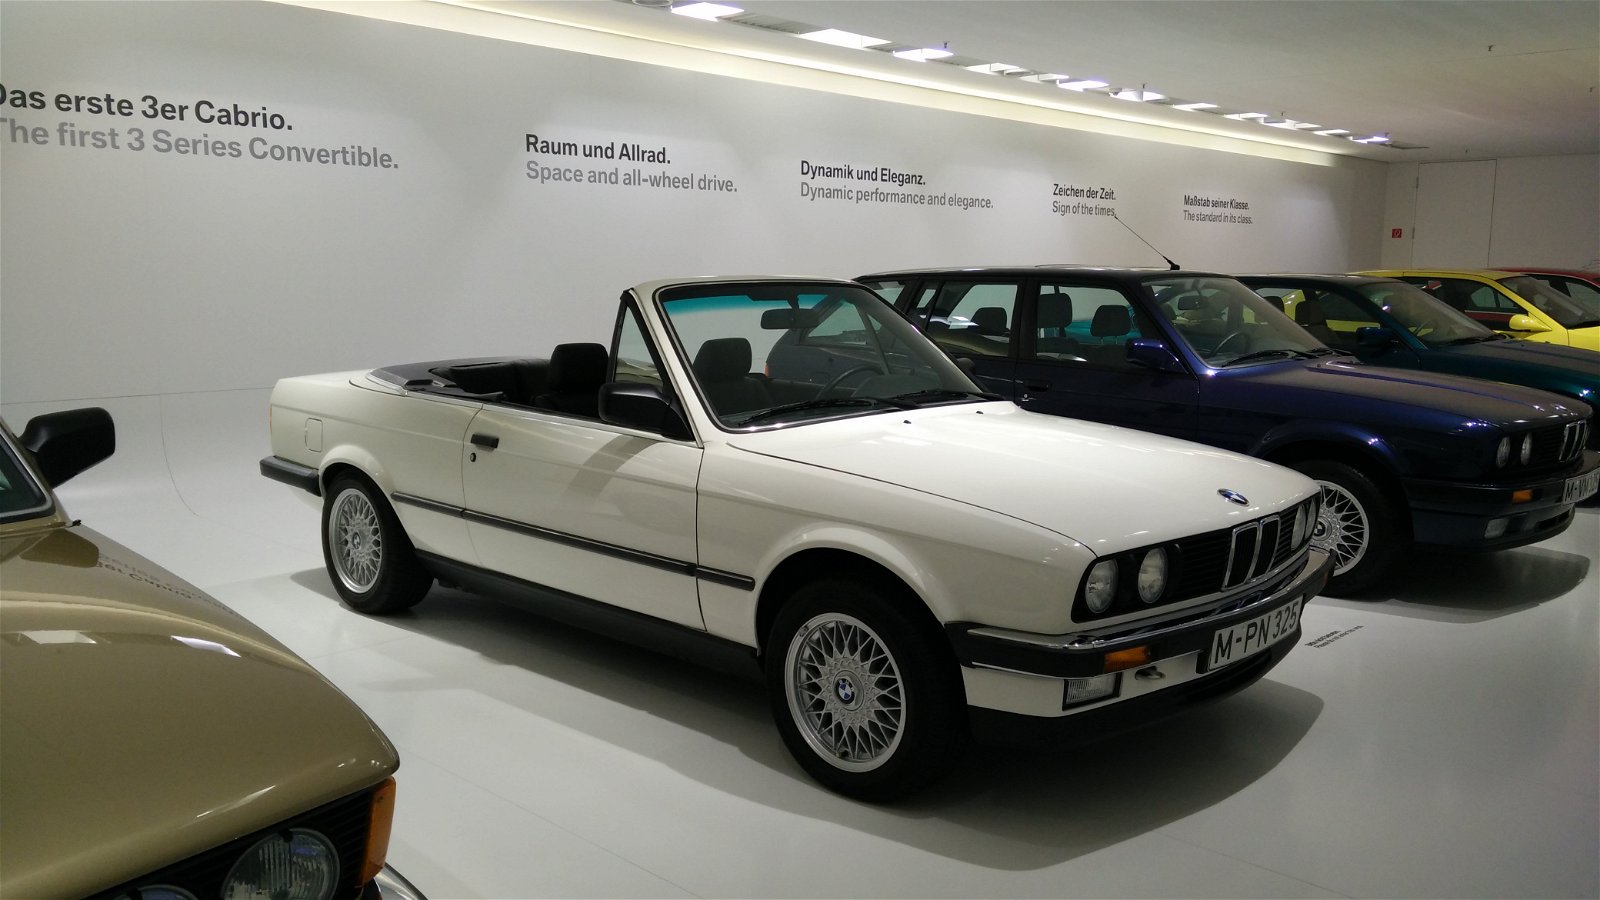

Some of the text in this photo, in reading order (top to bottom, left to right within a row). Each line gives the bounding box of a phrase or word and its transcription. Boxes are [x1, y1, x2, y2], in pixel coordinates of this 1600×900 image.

[54, 93, 134, 117] erste
[141, 94, 189, 122] 3er
[194, 99, 293, 131] Cabrio.
[56, 121, 121, 150] first
[126, 127, 146, 152] 3
[152, 128, 243, 159] Series
[248, 137, 400, 170] Convertible.
[525, 133, 671, 165] Raum und Allrad.
[525, 160, 738, 193] Space and all-wheel drive.
[800, 159, 926, 187] Dynamik und Eleganz.
[800, 181, 994, 211] Dynamic performance and elegance.
[1052, 183, 1116, 201] Zeichen der Zeit.
[1211, 197, 1230, 209] seiner
[1229, 198, 1250, 211] Klasse.
[1052, 200, 1071, 217] Sign
[1071, 202, 1081, 215] of
[1081, 202, 1094, 216] the
[1183, 209, 1195, 222] The
[1195, 211, 1223, 223] standard
[1222, 212, 1229, 223] in
[1229, 212, 1237, 224] its
[1214, 615, 1271, 664] M-PN
[1272, 601, 1299, 639] 325
